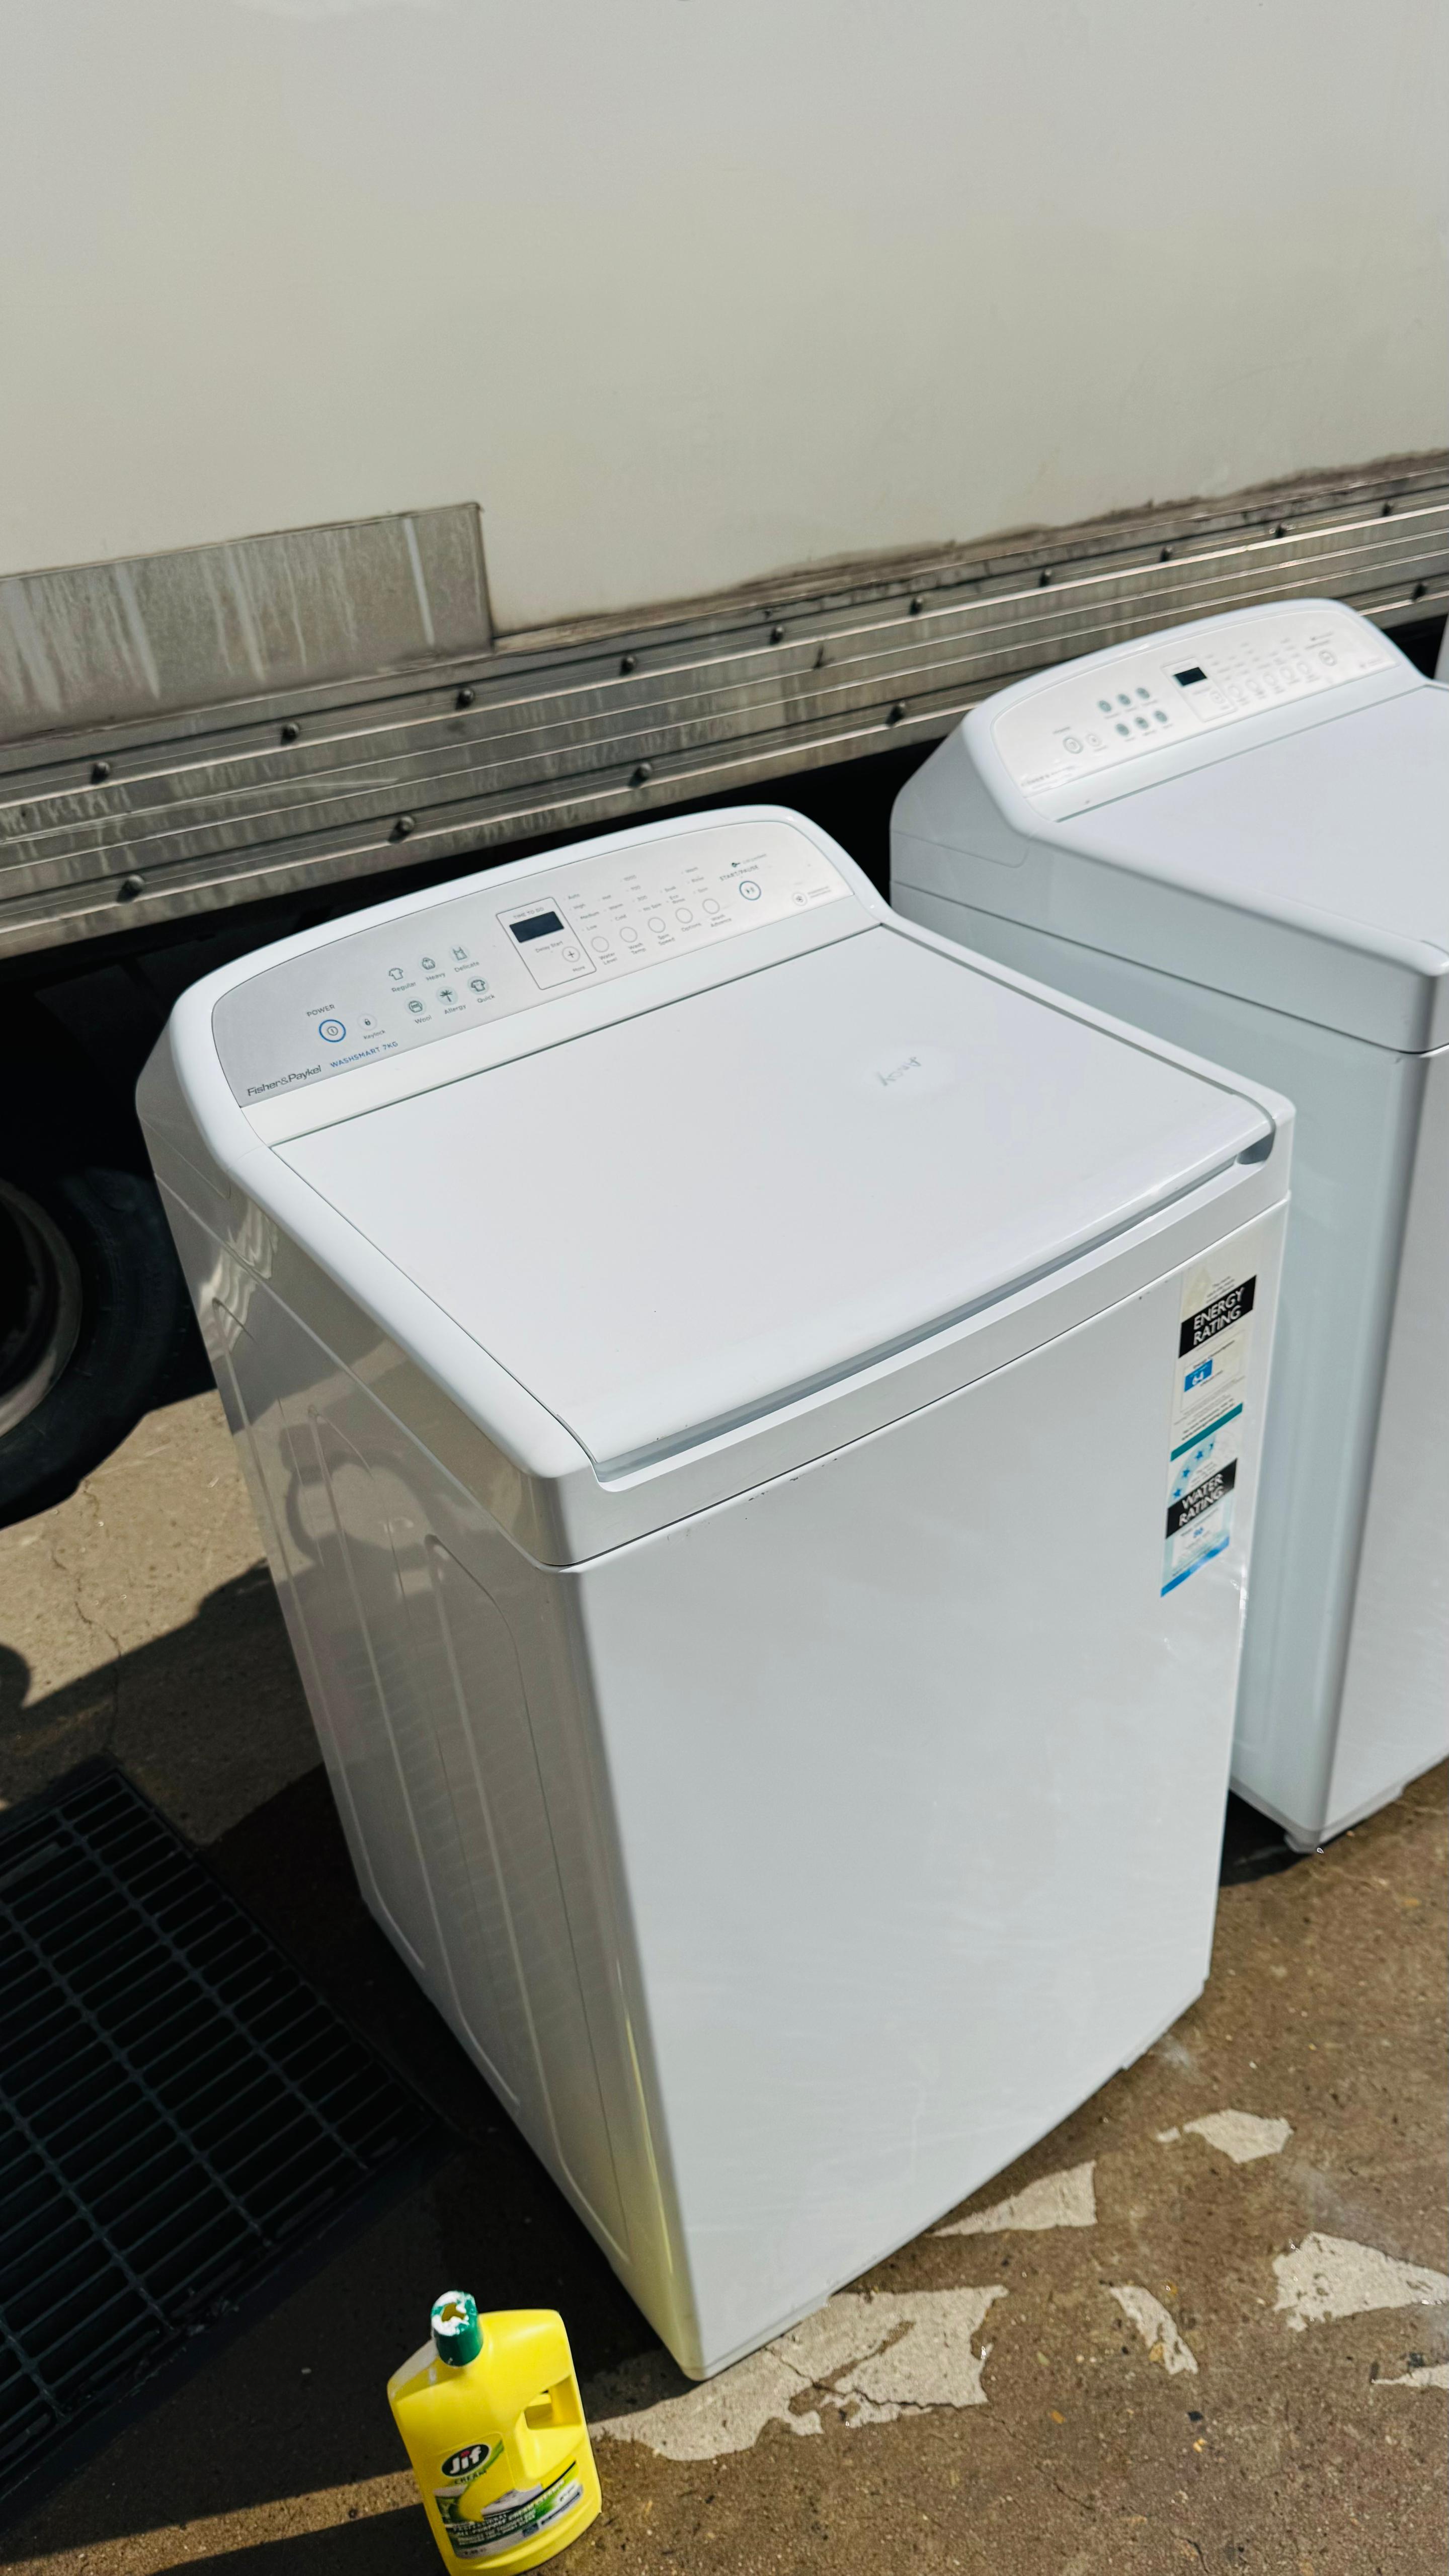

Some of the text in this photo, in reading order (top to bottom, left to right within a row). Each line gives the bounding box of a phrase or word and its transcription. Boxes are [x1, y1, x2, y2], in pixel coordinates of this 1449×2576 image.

[454, 961, 480, 973] Delicate
[426, 973, 446, 982] Heavy
[391, 982, 417, 992] Regular
[477, 994, 495, 1003] Quick
[306, 1004, 335, 1017] POWER
[444, 1004, 466, 1014] Allergy
[414, 1015, 432, 1024] Wool
[363, 1029, 386, 1040] Keylock
[247, 1041, 398, 1096] Fisher&Paykel WASHSMART 7KG
[1193, 1286, 1245, 1330] ENERGY
[1193, 1305, 1242, 1345] RATING
[1182, 1473, 1224, 1509] WATER
[1179, 1486, 1224, 1526] RATING
[449, 2446, 482, 2474] Jif
